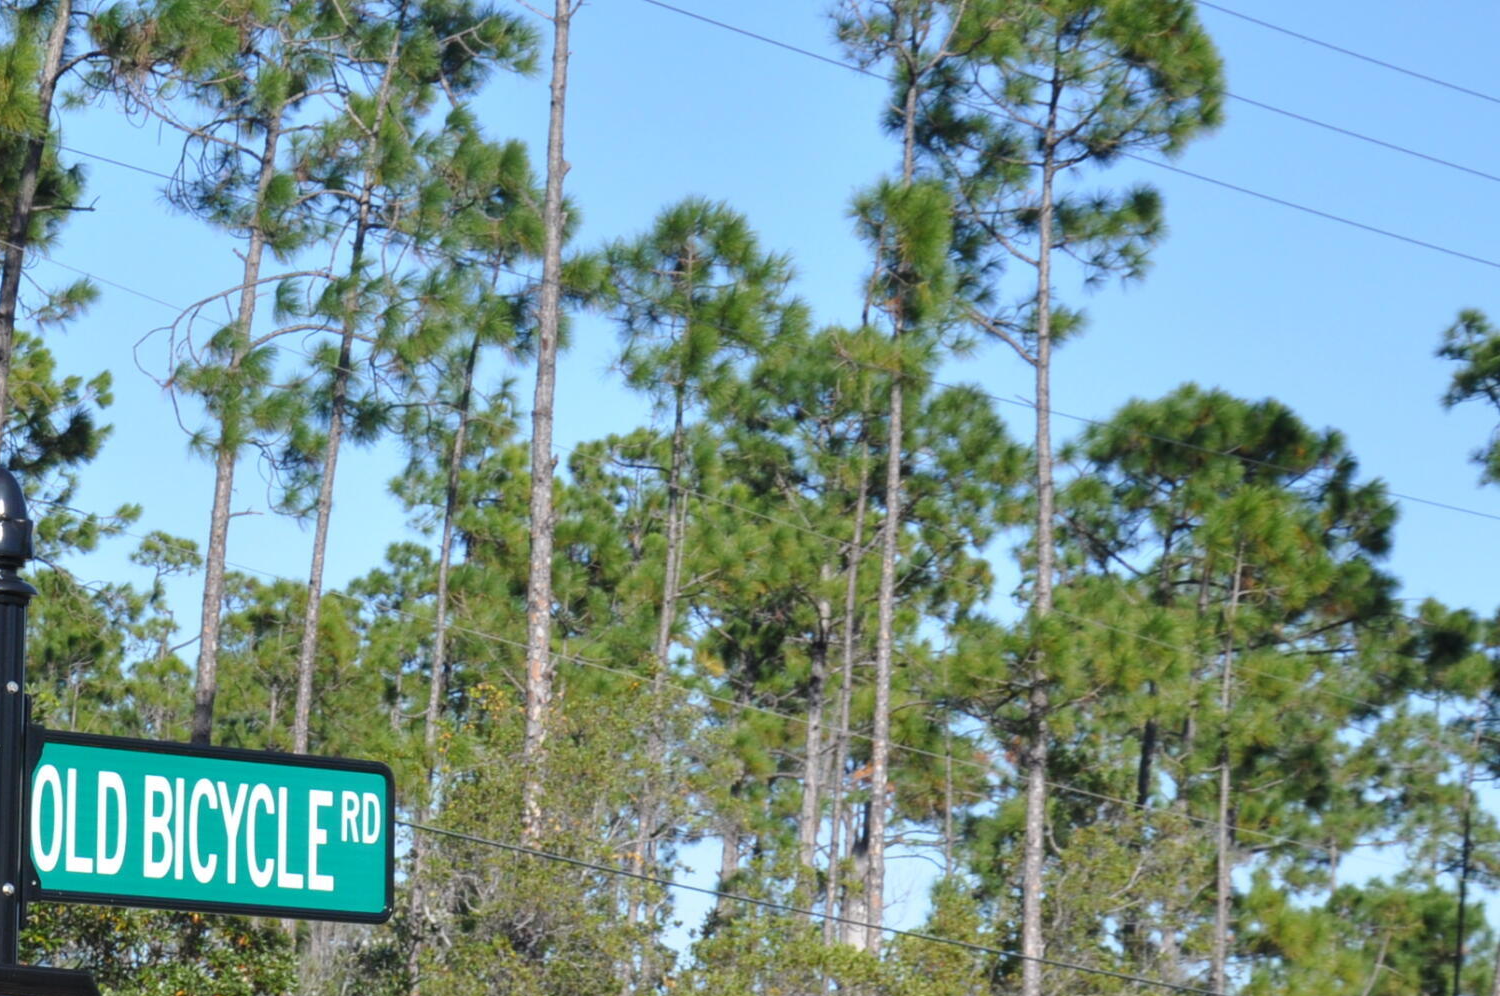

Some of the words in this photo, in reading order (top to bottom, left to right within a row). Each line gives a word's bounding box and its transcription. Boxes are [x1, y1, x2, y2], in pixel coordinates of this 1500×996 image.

[31, 764, 127, 875] OLD
[143, 774, 334, 891] BICYCLE
[341, 790, 381, 844] RD
